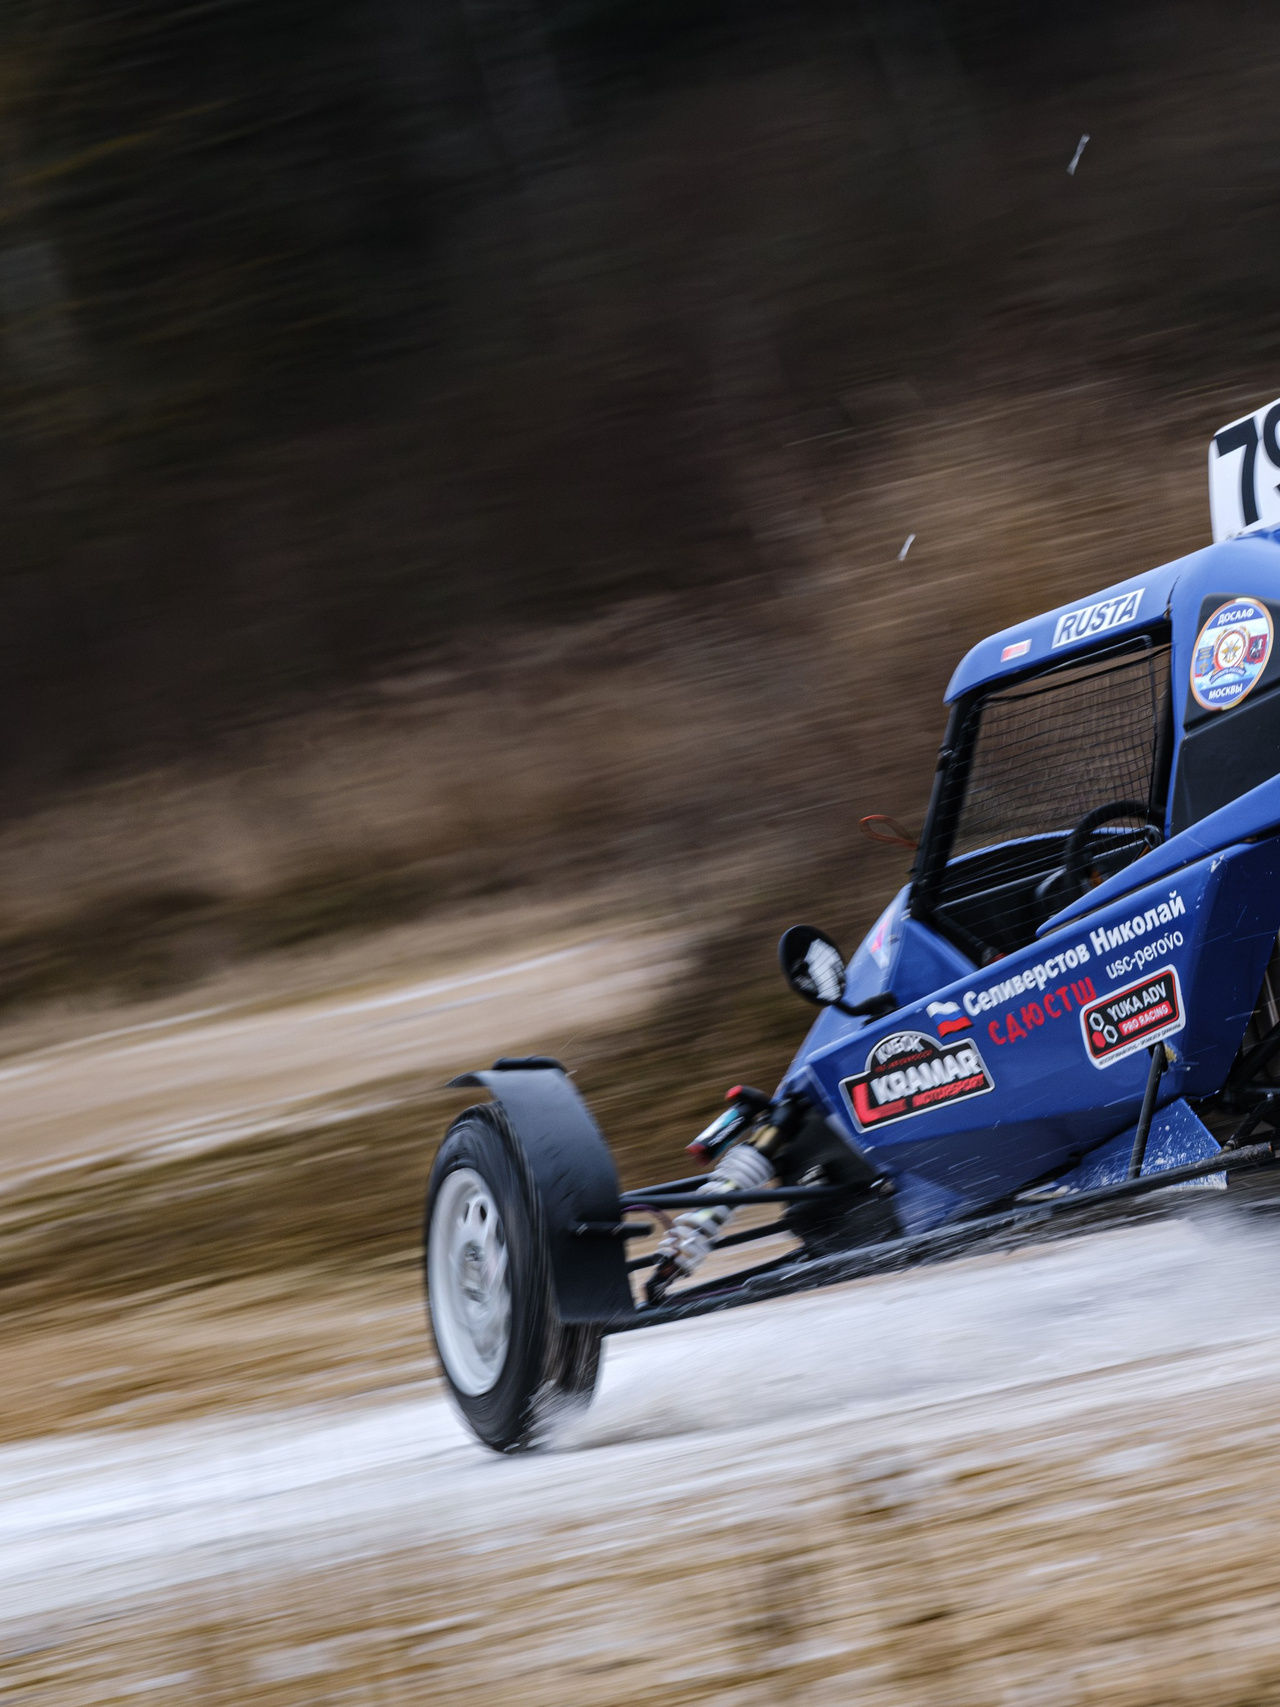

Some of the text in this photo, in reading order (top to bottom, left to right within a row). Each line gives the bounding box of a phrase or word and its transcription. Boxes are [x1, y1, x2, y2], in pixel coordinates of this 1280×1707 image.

[1056, 593, 1140, 643] RUSTA
[1218, 608, 1254, 625] ДОСААФ
[1208, 683, 1243, 700] МОСКВЫ
[963, 890, 1186, 1016] Селиверстов Николай
[1106, 930, 1184, 980] usc-perovo
[987, 977, 1097, 1046] СДЮСТШ
[1107, 981, 1167, 1022] YUKA ADV
[1122, 1004, 1168, 1033] PRO RACING
[870, 1049, 983, 1105] KRAMAR
